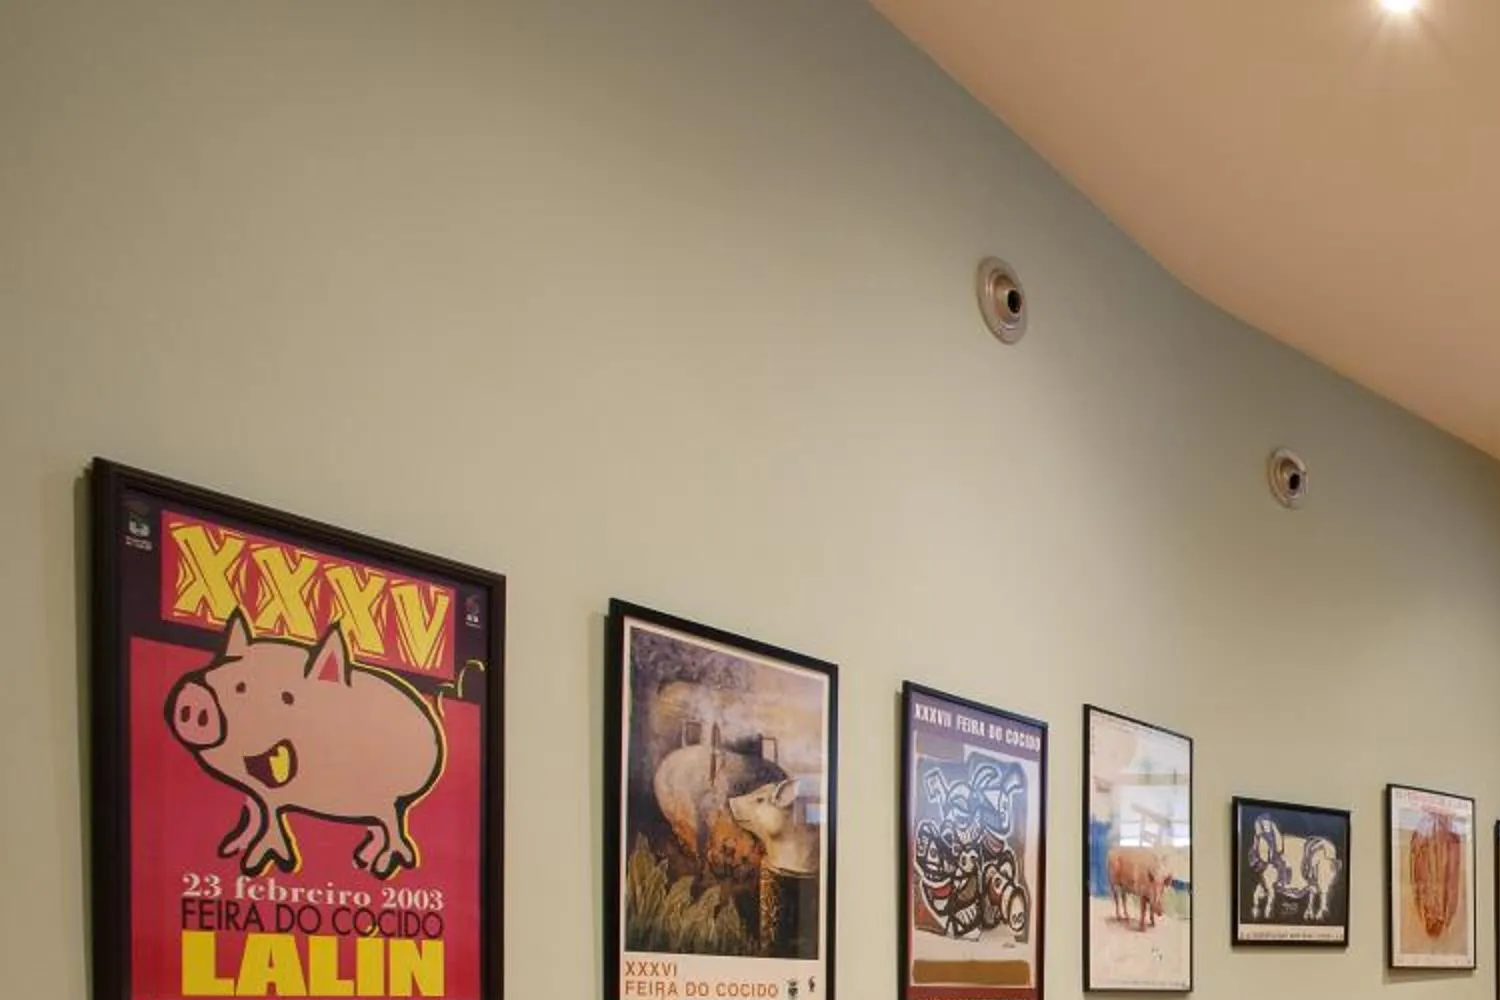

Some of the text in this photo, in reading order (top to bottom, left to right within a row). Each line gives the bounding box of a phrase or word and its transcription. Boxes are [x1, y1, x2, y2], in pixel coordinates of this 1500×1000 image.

[170, 522, 450, 669] XXXV
[956, 713, 985, 737] FEIRA
[182, 873, 444, 911] 23 febreiro 2003
[180, 898, 443, 940] FEIRA DO COCIDO
[625, 961, 677, 977] XXXVI
[625, 980, 780, 998] FEIRA DO COCIDO
